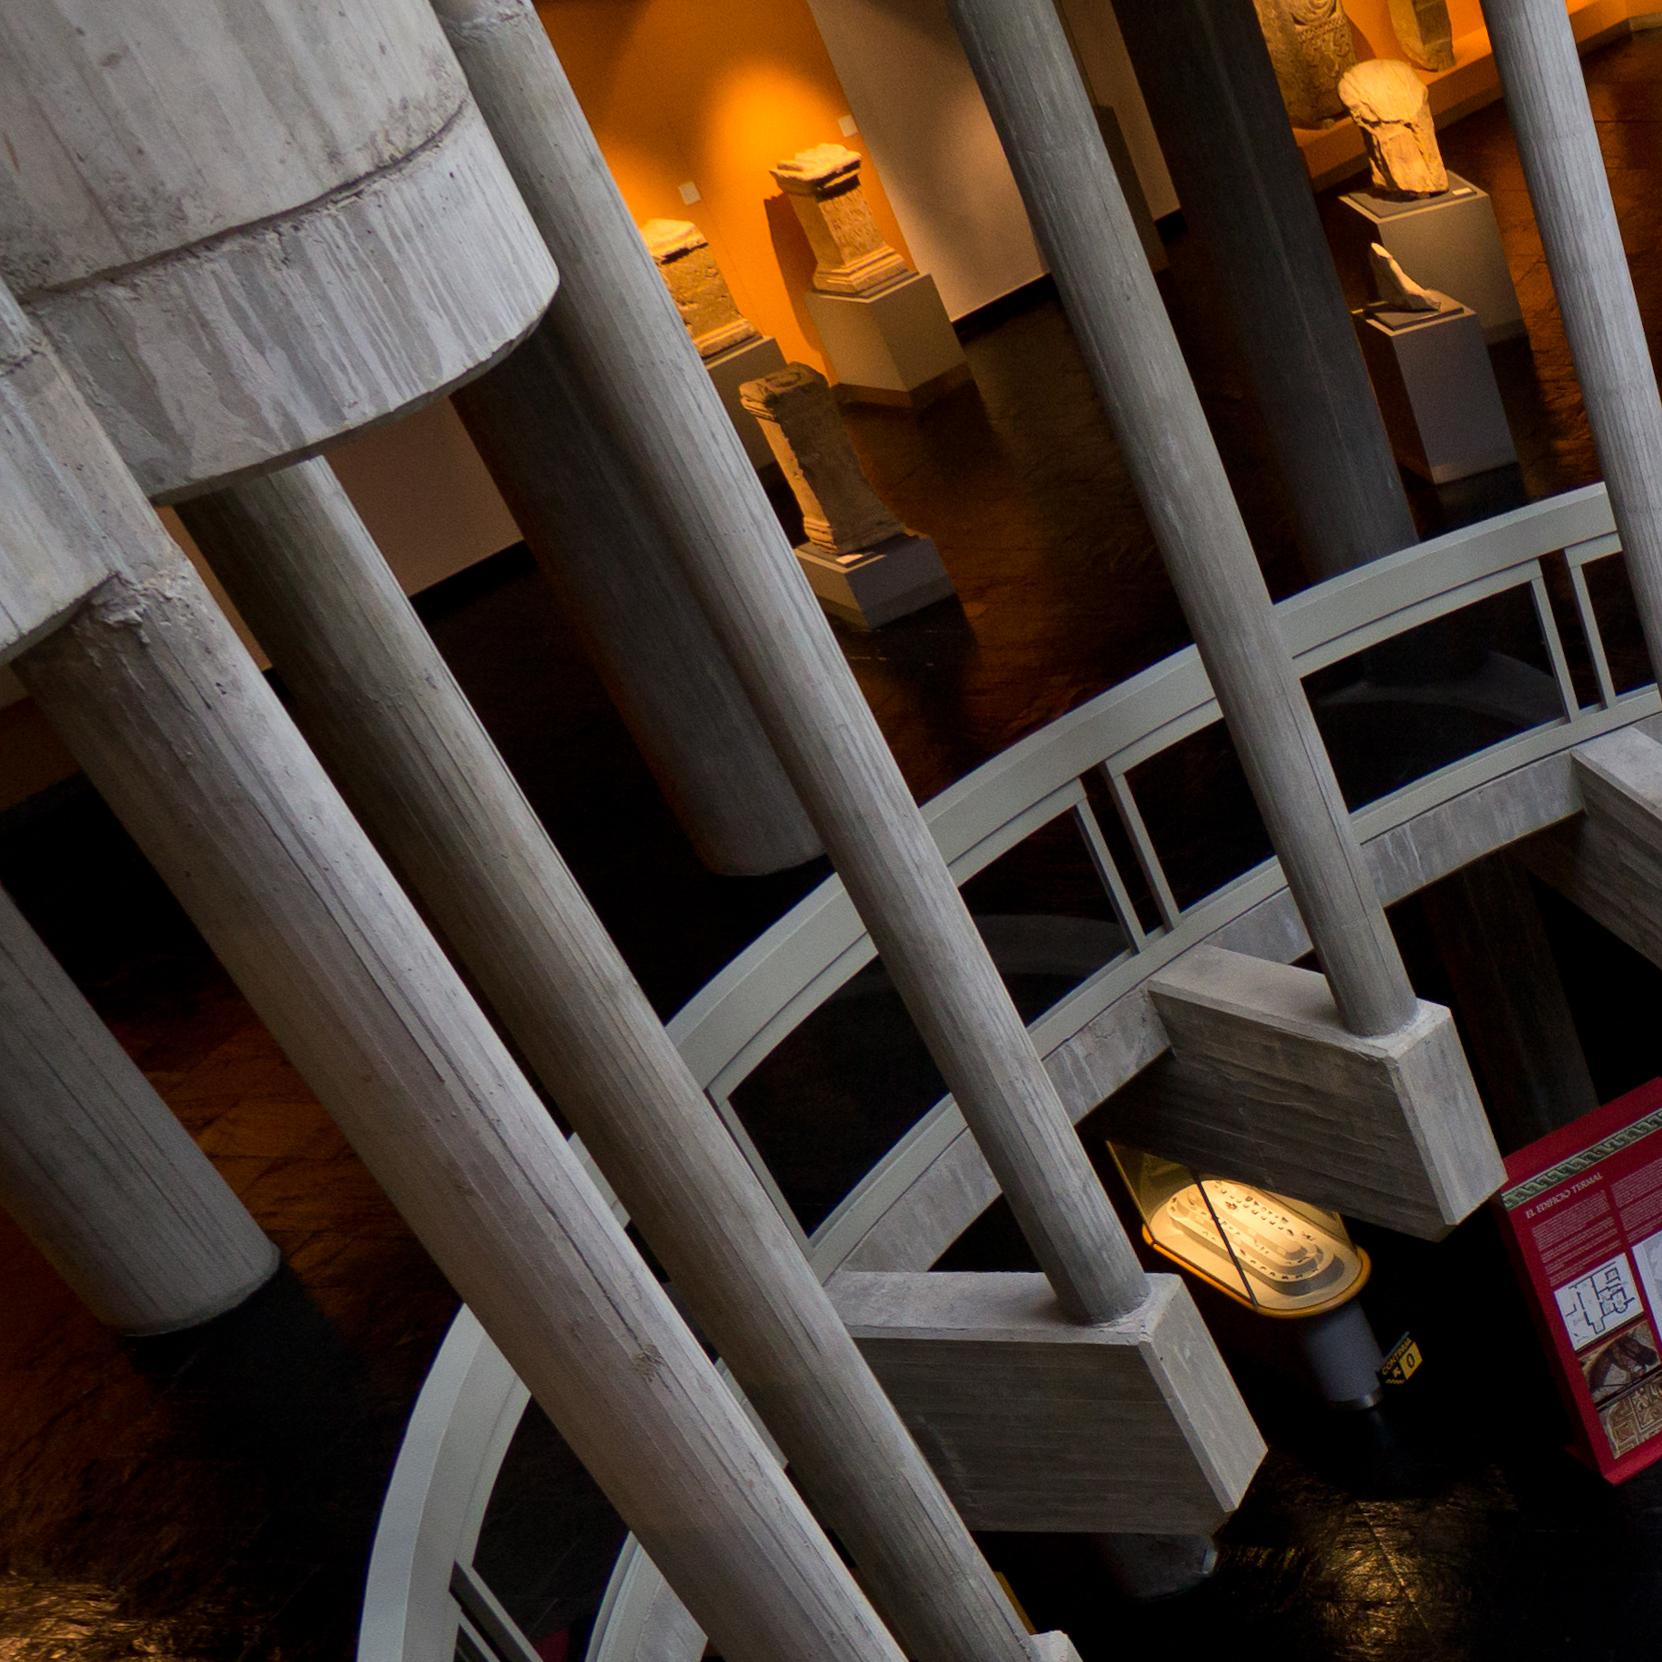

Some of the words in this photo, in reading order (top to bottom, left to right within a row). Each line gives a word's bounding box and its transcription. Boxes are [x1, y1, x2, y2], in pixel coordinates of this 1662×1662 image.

[1525, 1208, 1536, 1219] EL
[1535, 1189, 1571, 1213] EDIFICIO
[1570, 1172, 1603, 1194] TERMAL
